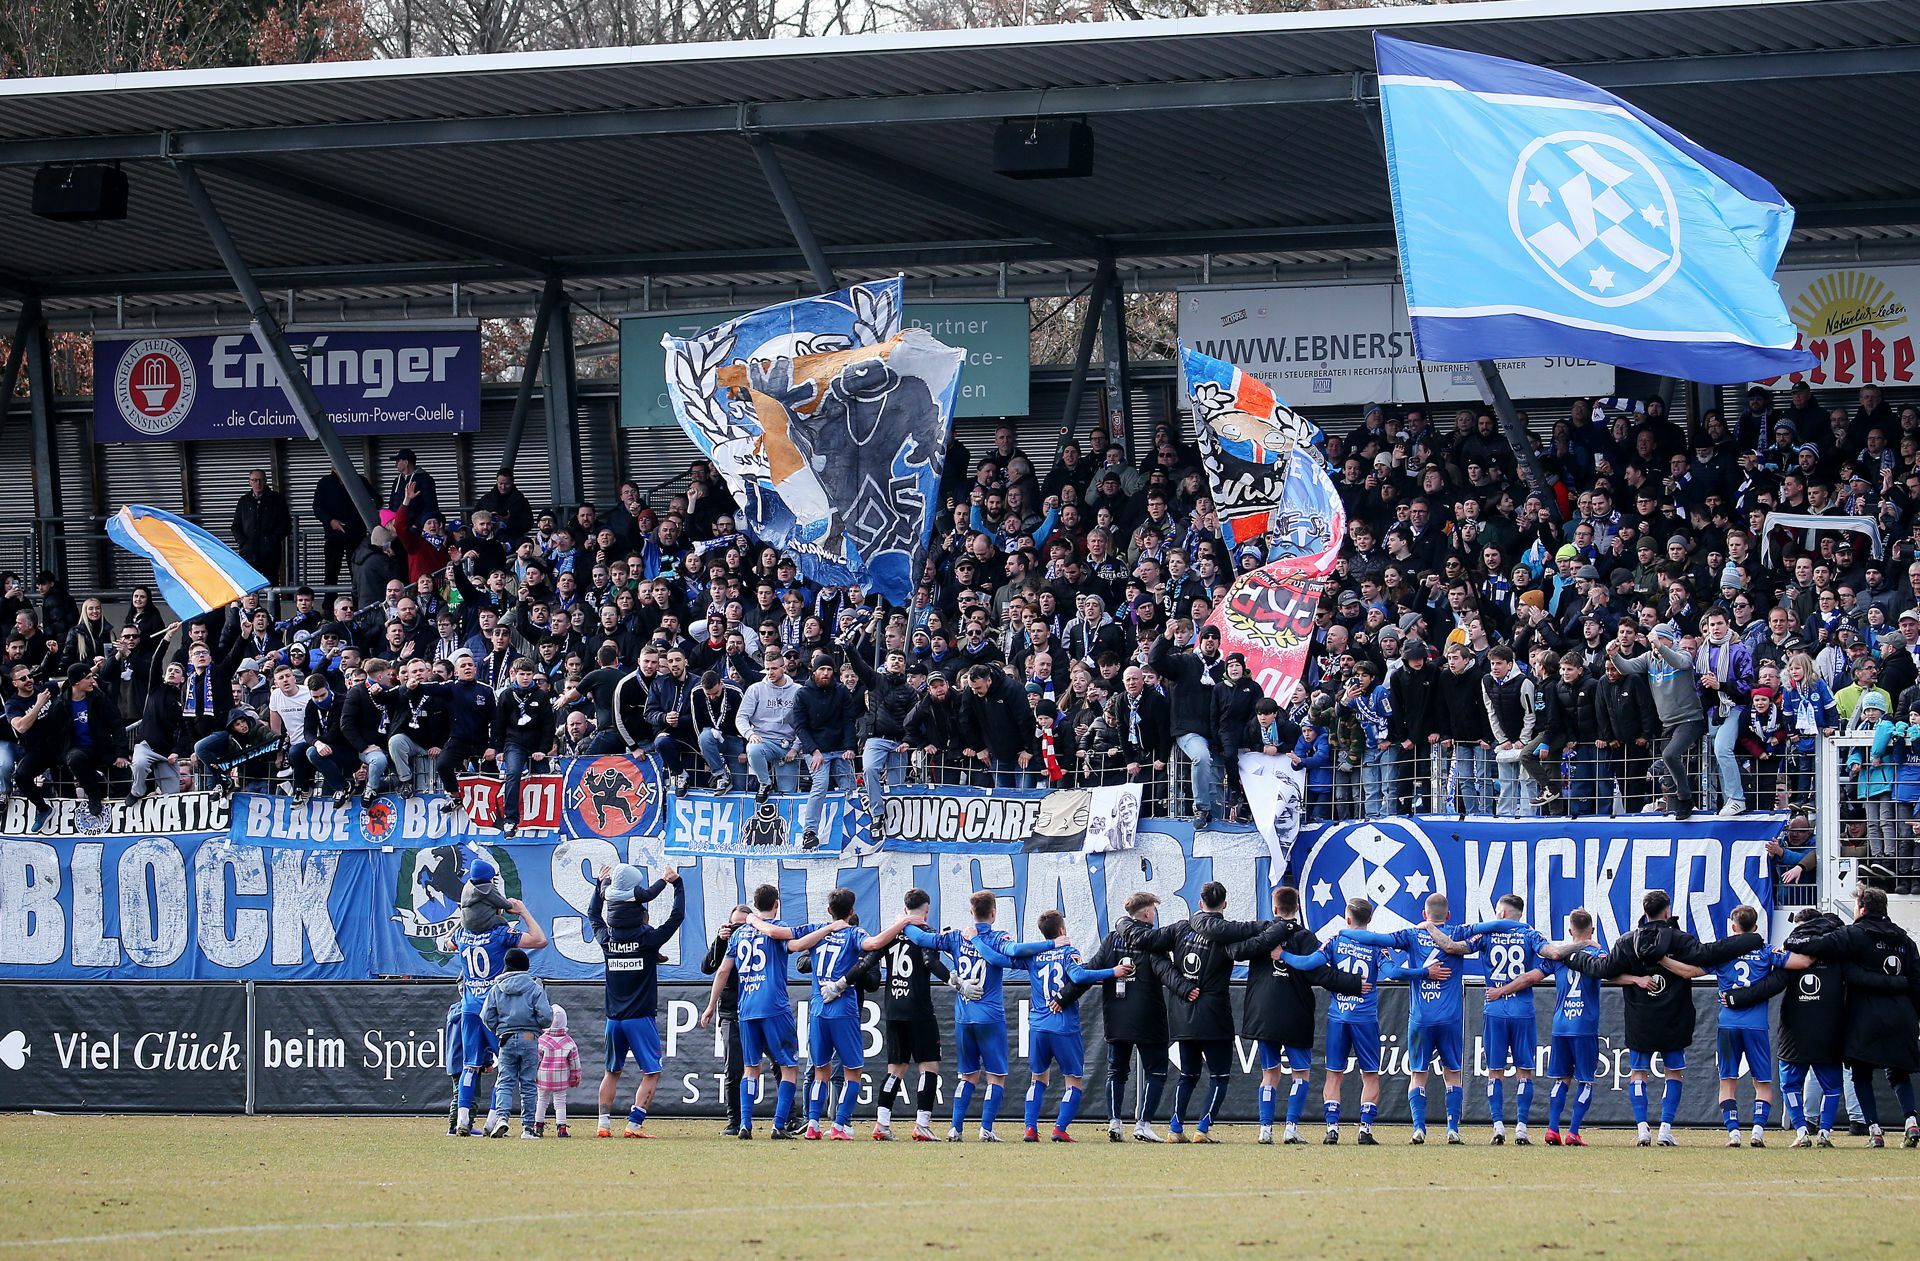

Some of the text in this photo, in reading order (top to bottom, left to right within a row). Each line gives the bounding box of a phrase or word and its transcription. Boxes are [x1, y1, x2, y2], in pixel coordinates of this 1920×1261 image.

[911, 318, 988, 335] Partner
[1285, 368, 1347, 379] STEUERBERATER
[128, 408, 182, 430] ENSINGEN
[566, 782, 657, 810] 19 95
[247, 796, 353, 842] BLAUE
[675, 800, 735, 843] SEK
[885, 799, 1041, 841] OUNG CARE
[0, 834, 345, 967] BLOCK
[1464, 838, 1770, 960] KICKERS
[462, 946, 491, 979] 10
[609, 960, 642, 970] uhlsport
[737, 937, 767, 973] 25
[816, 944, 841, 977] 17
[888, 943, 913, 978] 16
[1337, 946, 1373, 962] Kickers
[1490, 945, 1525, 981] 28
[744, 982, 761, 995] vpv
[891, 979, 908, 987] Otto
[1037, 962, 1065, 1000] 13
[1567, 970, 1581, 998] 2
[1732, 961, 1751, 989] 3
[891, 987, 910, 999] vpv
[1421, 991, 1441, 1003] vpv
[1564, 1000, 1584, 1008] Moos
[1338, 1002, 1356, 1013] vpv
[1564, 1008, 1583, 1020] vpv
[53, 1030, 447, 1080] Viel Glück beim Spiel
